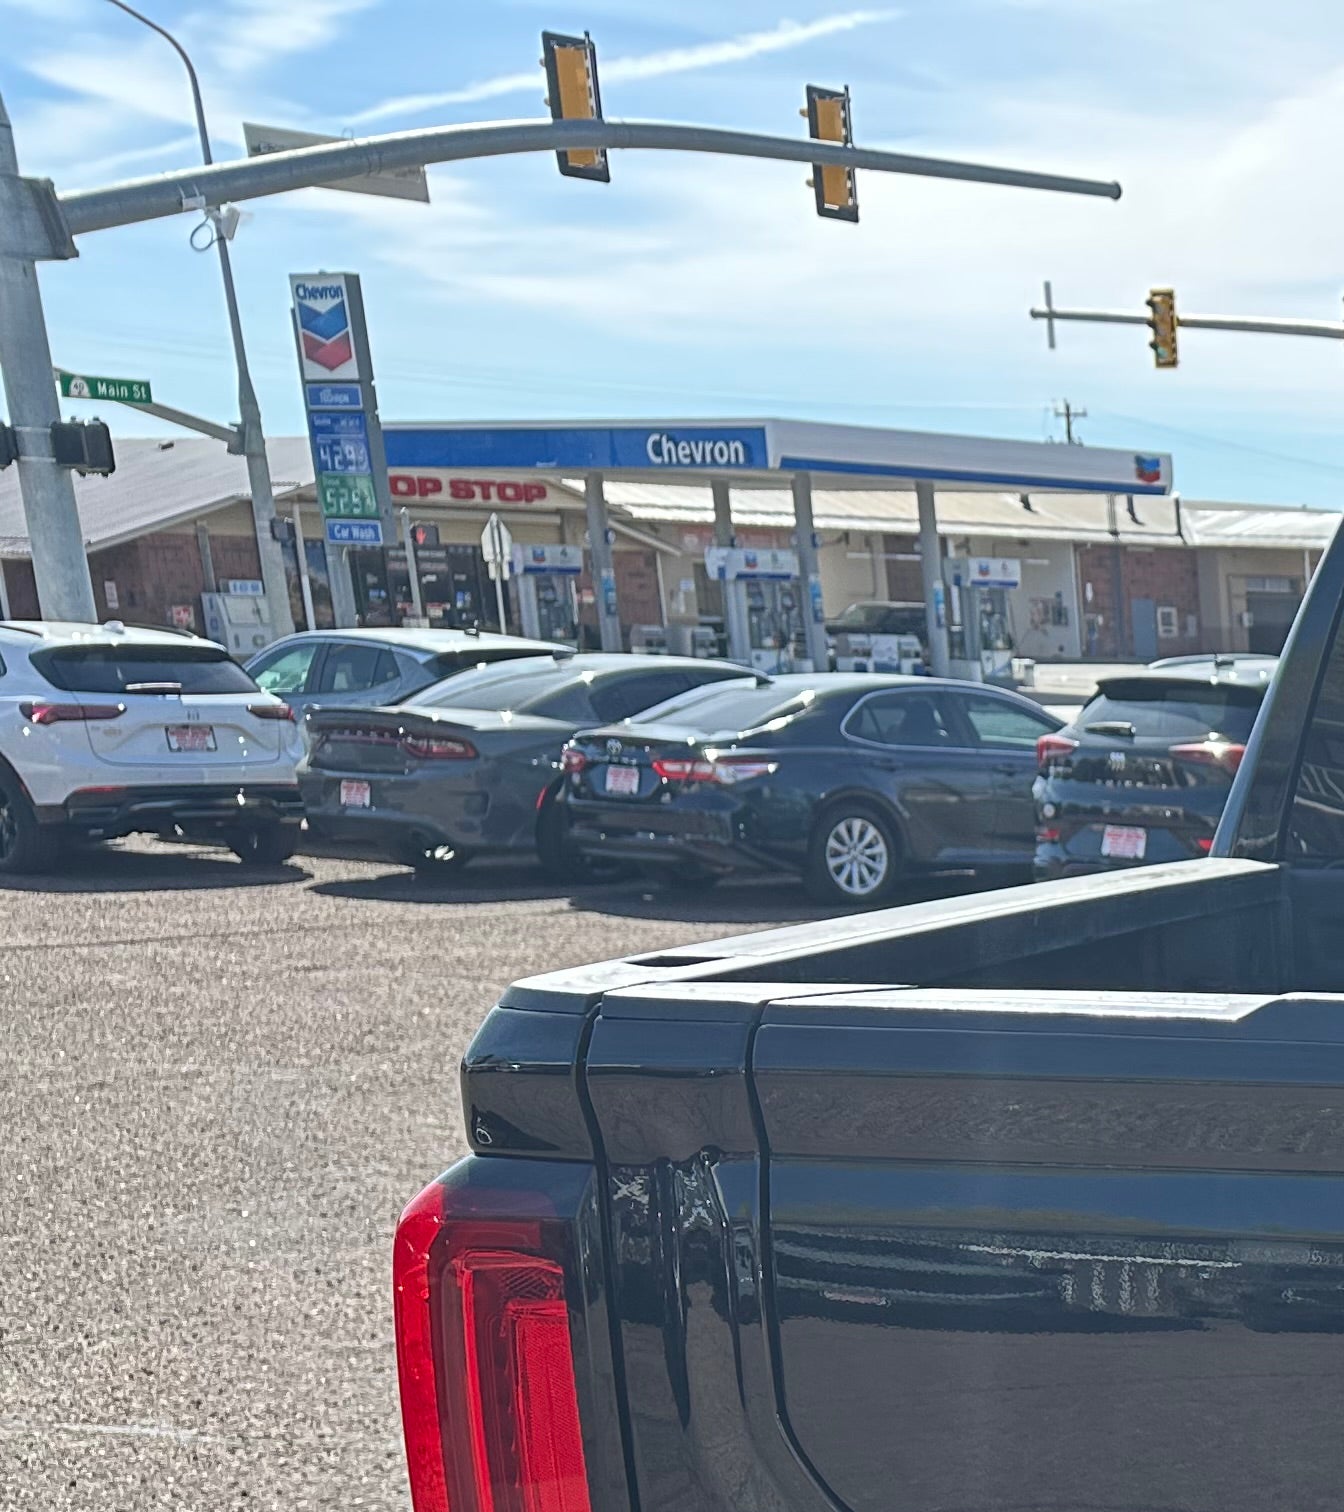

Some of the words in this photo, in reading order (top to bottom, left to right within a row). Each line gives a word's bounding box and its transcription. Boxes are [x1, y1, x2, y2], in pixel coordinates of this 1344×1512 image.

[295, 283, 343, 299] Chevron
[97, 380, 128, 398] Main
[133, 384, 147, 400] St
[646, 433, 745, 465] Chevron
[388, 474, 442, 497] OP
[449, 479, 547, 503] STOP
[351, 526, 376, 539] Wash
